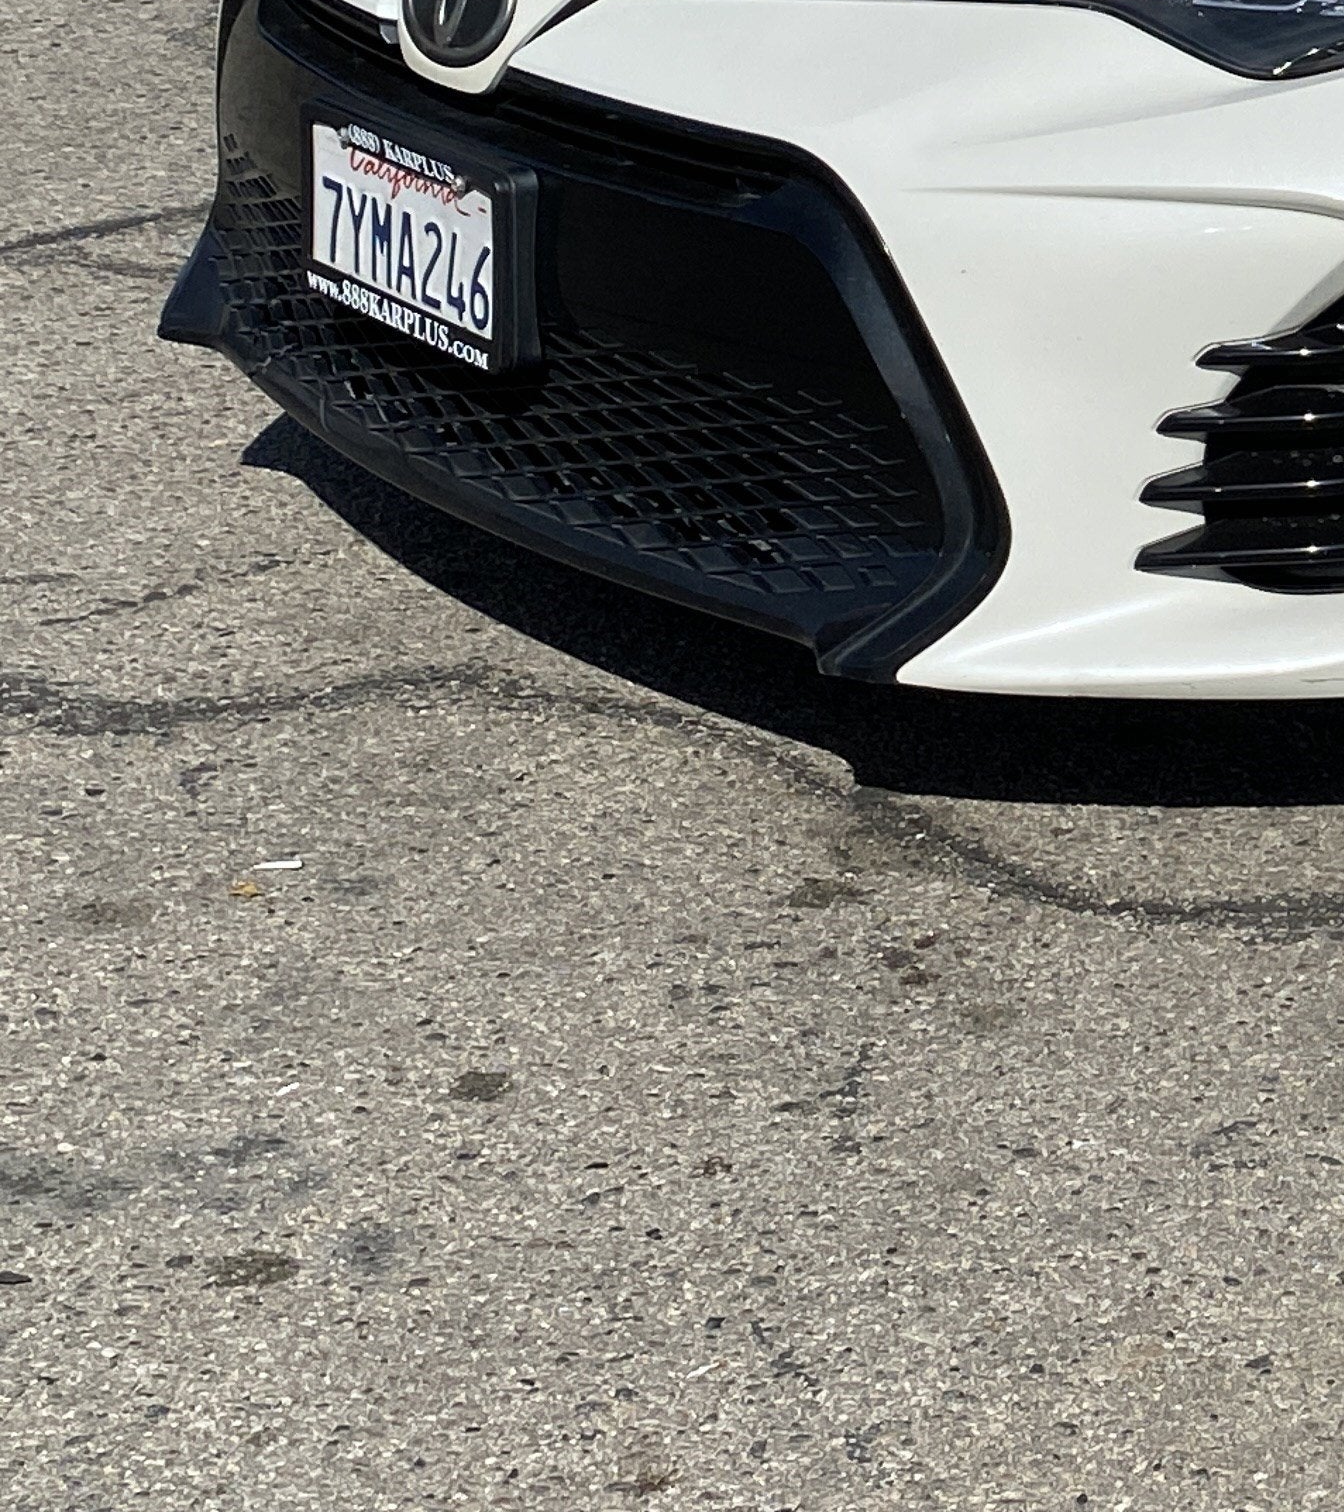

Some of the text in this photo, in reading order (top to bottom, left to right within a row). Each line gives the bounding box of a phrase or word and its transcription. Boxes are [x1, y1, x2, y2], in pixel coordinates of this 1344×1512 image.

[347, 123, 456, 183] (888) KARPLUS
[349, 146, 471, 217] California
[322, 175, 492, 332] 7YMA246
